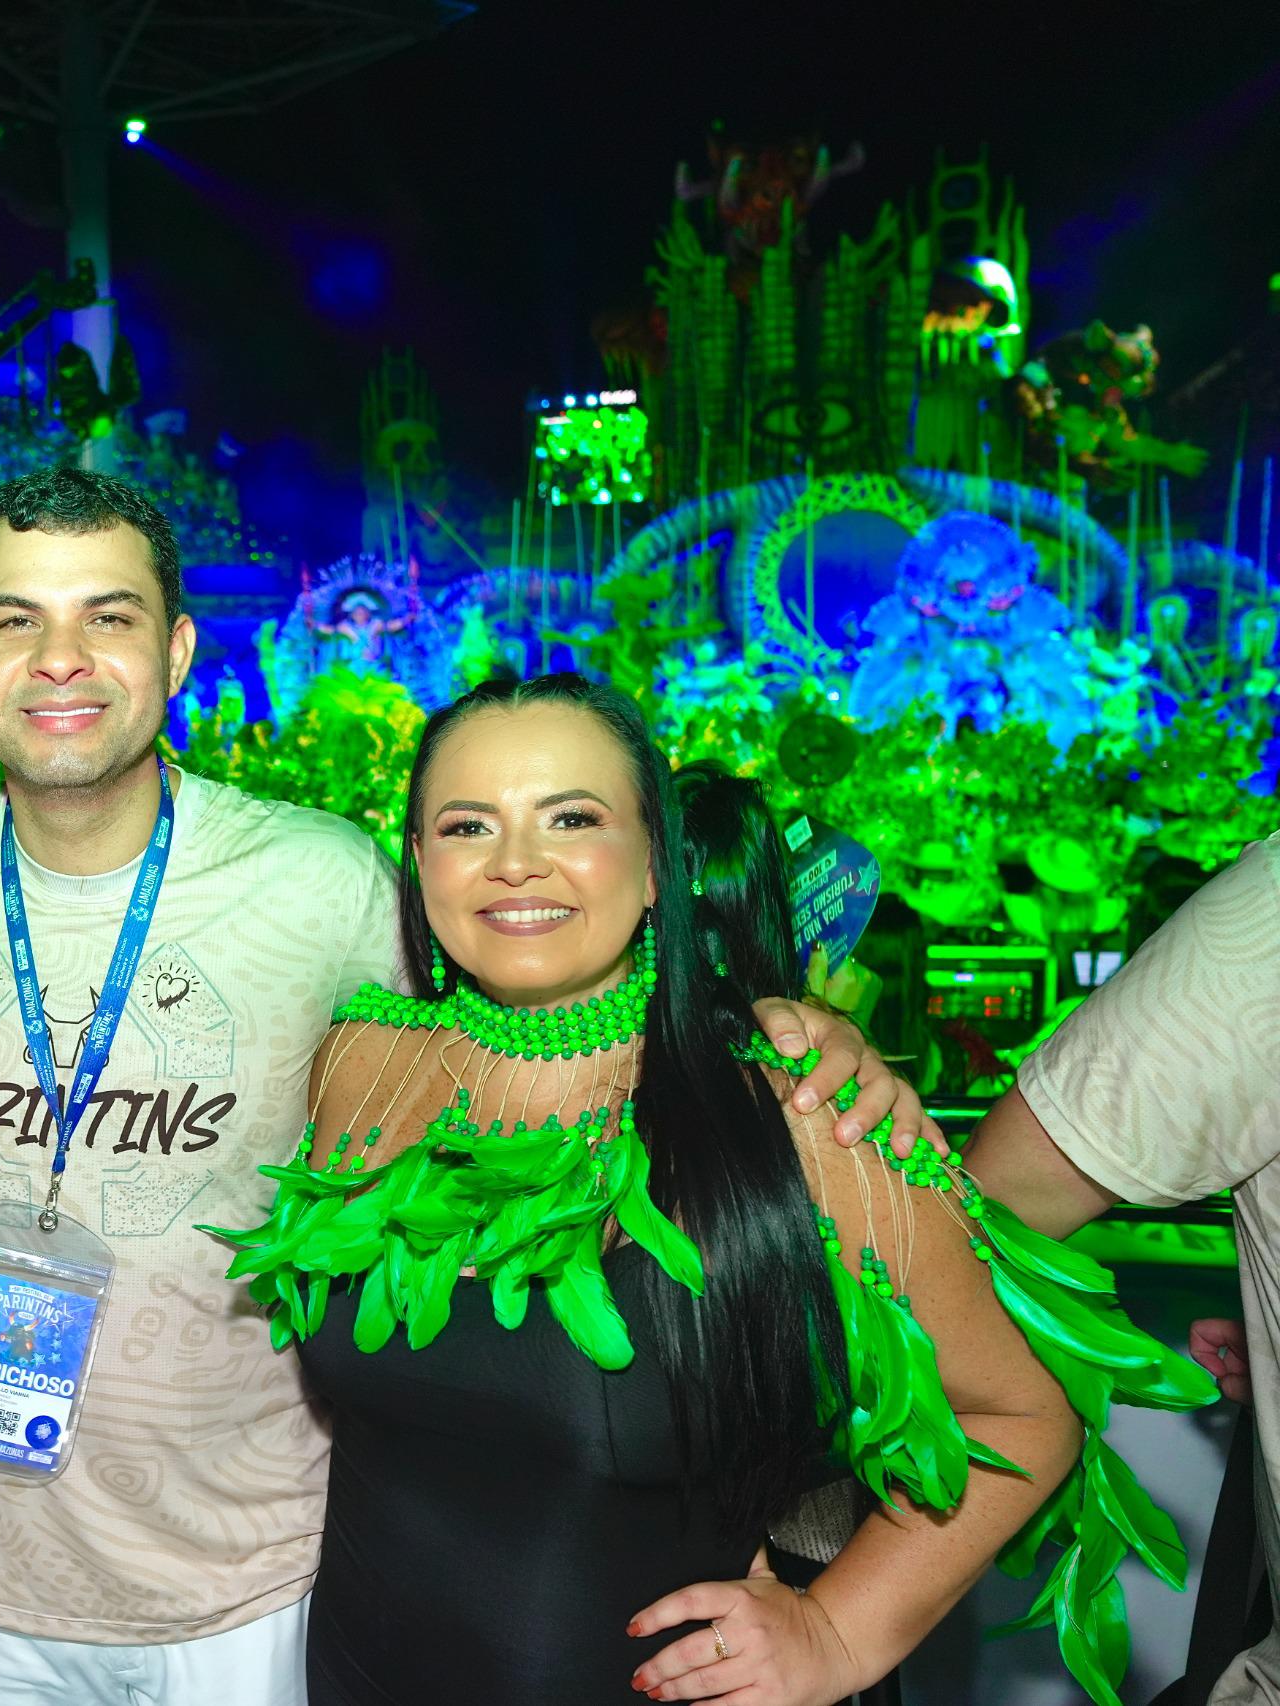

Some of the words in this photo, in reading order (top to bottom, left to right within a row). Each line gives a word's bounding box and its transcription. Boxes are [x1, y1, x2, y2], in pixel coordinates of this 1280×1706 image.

[138, 863, 159, 907] AMAZONAS
[813, 871, 855, 914] TURISMO
[822, 897, 844, 926] DIGA
[21, 976, 37, 1018] AMAZONAS
[94, 1012, 114, 1049] PARINTINS
